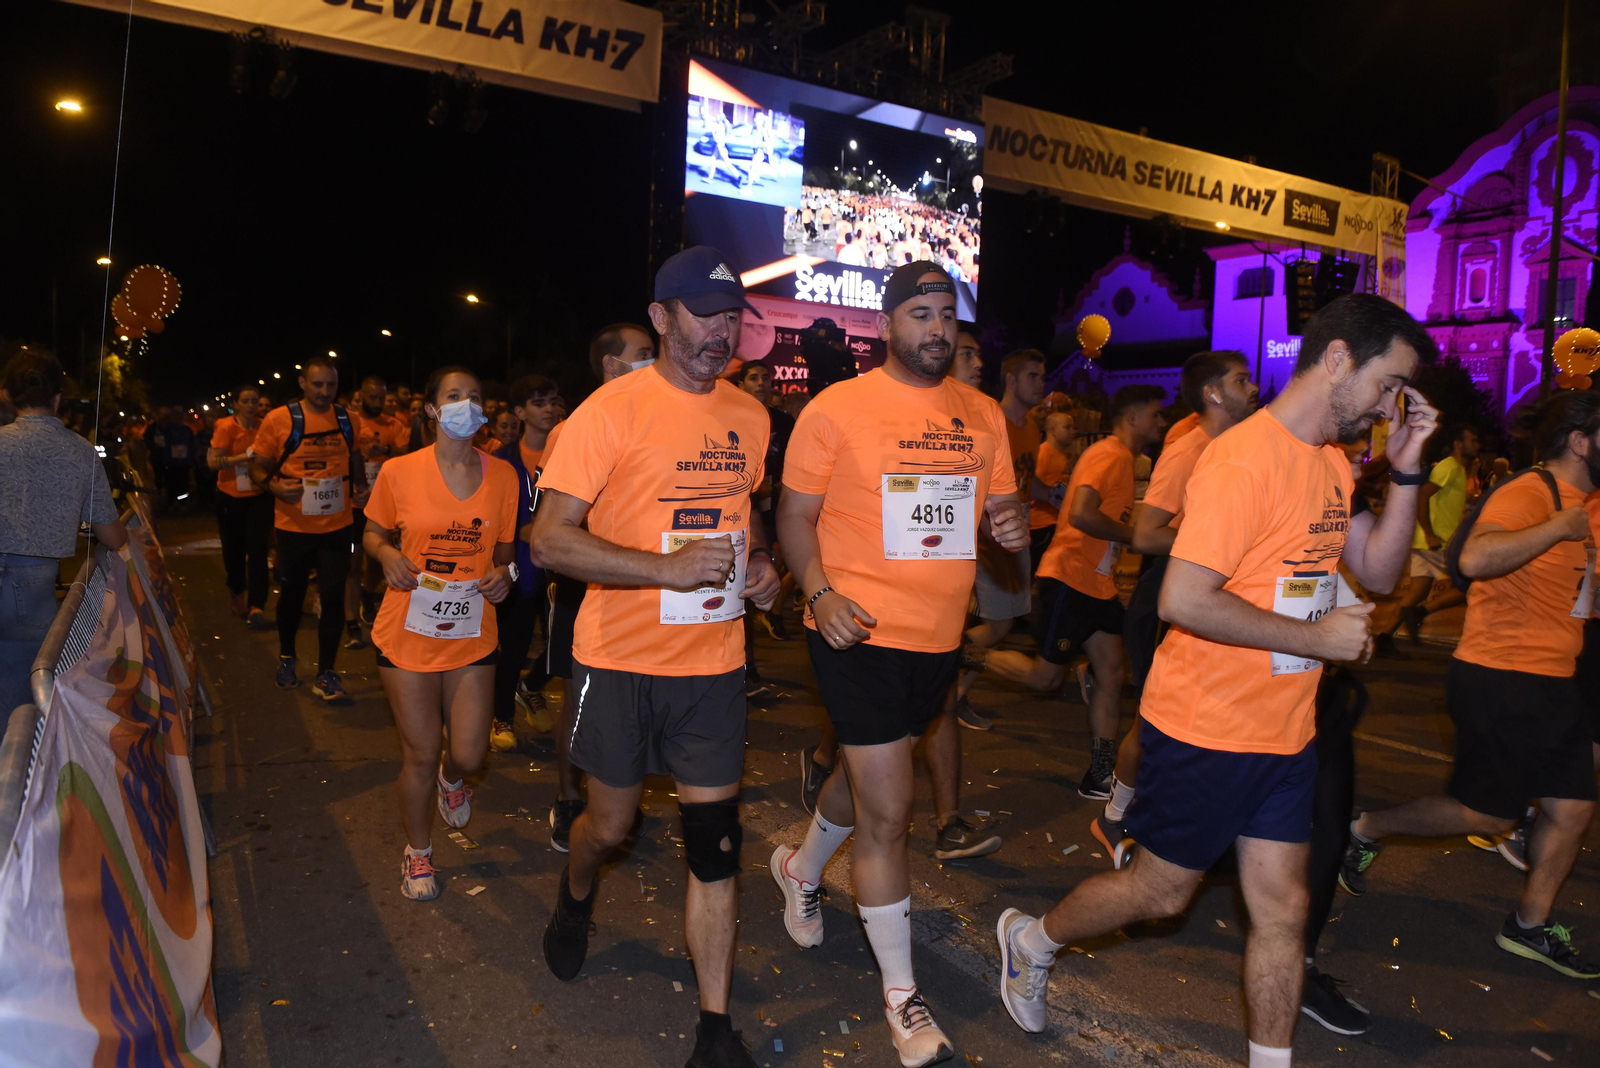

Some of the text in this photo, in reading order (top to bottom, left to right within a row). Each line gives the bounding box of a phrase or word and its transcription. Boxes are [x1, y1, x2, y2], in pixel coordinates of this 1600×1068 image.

[321, 0, 525, 45] VILLA
[988, 125, 1127, 181] NOCTURNA
[1133, 160, 1224, 203] SEVILLA
[709, 273, 736, 282] adidas
[767, 309, 798, 319] Cruzcampo
[1267, 339, 1302, 355] Sevill
[773, 365, 809, 380] XXXI
[922, 432, 973, 442] NOCTURNA
[899, 441, 947, 451] SEVILLA
[699, 451, 746, 460] NOCTURNA
[676, 461, 723, 472] SEVILLA
[313, 489, 339, 501] 16676
[911, 504, 954, 524] 4816
[430, 534, 461, 542] SEVILLA
[446, 529, 482, 537] NOCTURNA
[432, 601, 470, 616] 4736
